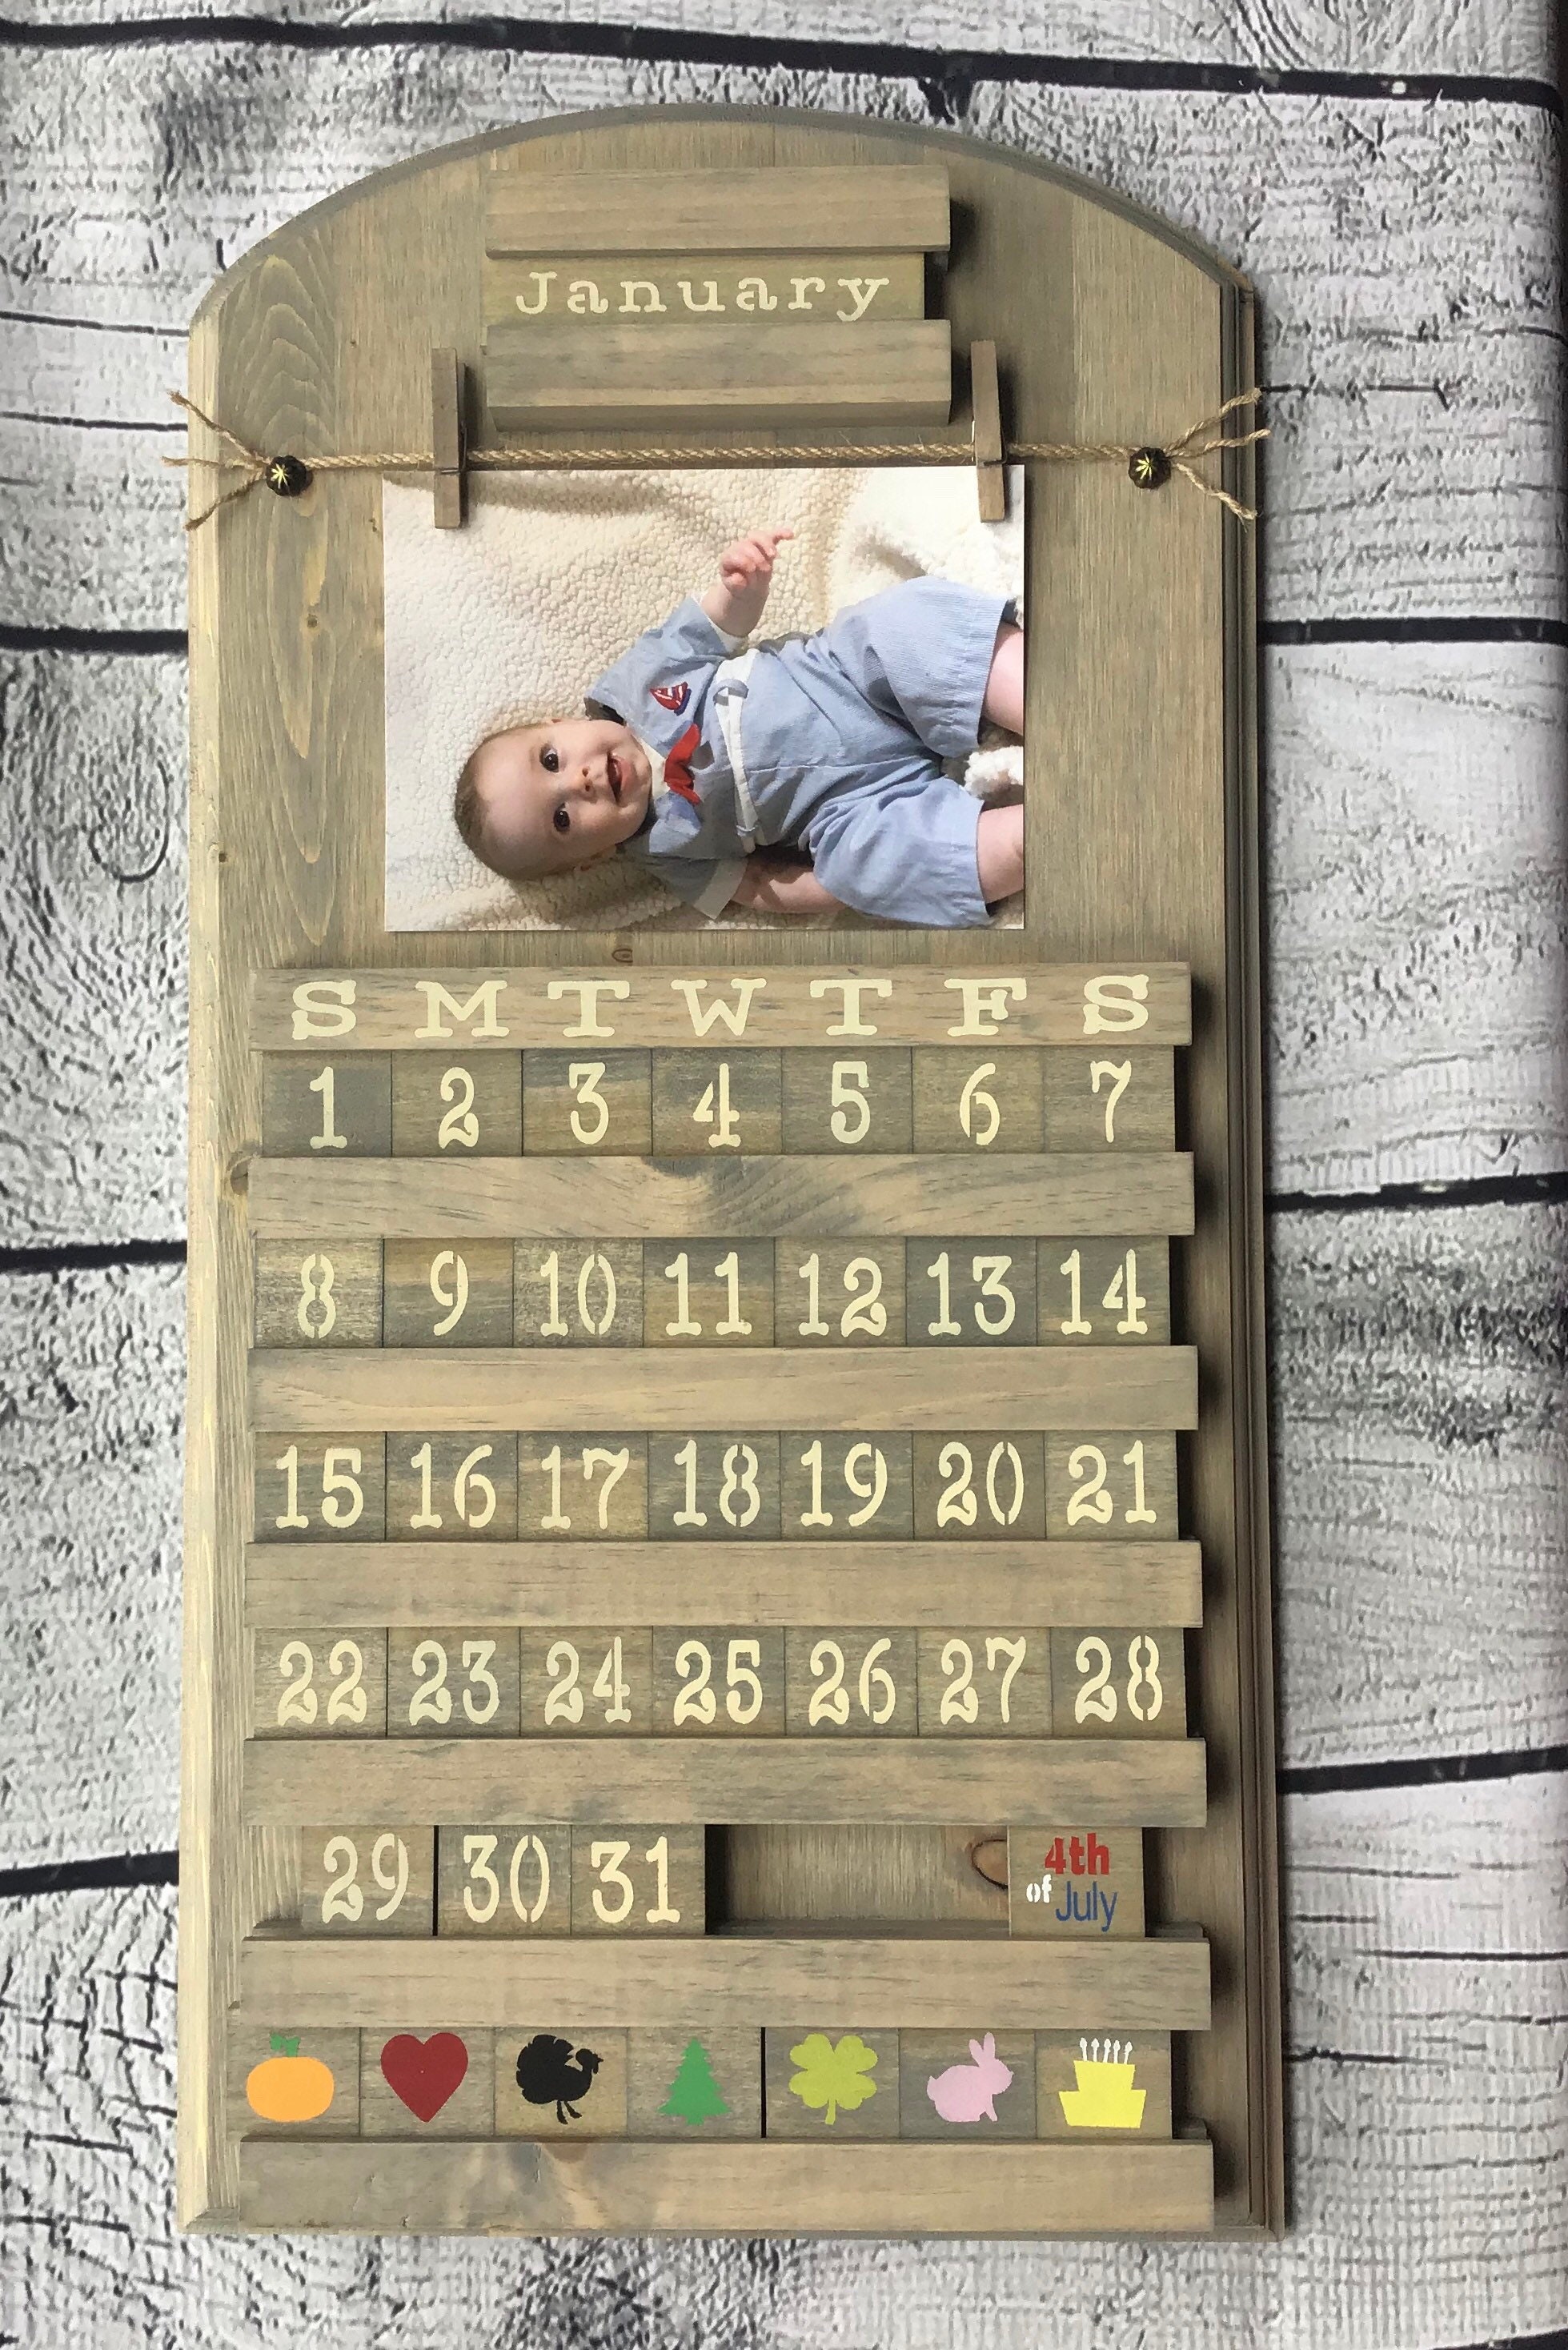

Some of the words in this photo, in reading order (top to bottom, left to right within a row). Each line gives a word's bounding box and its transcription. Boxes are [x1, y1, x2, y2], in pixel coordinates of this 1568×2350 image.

[516, 272, 889, 320] January
[292, 980, 356, 1040] S
[415, 981, 509, 1038] M
[547, 981, 629, 1037] T
[671, 978, 766, 1037] W
[810, 979, 892, 1035] T
[944, 978, 1027, 1037] F
[1083, 974, 1149, 1034] S
[310, 1066, 347, 1148] 1
[439, 1067, 479, 1148] 2
[569, 1063, 608, 1145] 3
[692, 1063, 740, 1147] 4
[831, 1061, 870, 1143] 5
[960, 1063, 1000, 1145] 6
[1090, 1061, 1131, 1142] 7
[297, 1253, 336, 1337] 8
[430, 1251, 468, 1335] 9
[539, 1251, 616, 1336] 10
[665, 1253, 752, 1336] 11
[799, 1253, 886, 1337] 12
[928, 1253, 1015, 1335] 13
[1061, 1249, 1148, 1334] 14
[276, 1446, 363, 1528] 15
[410, 1442, 495, 1529] 16
[541, 1446, 628, 1529] 17
[674, 1440, 760, 1526] 18
[800, 1441, 887, 1526] 19
[937, 1442, 1024, 1527] 20
[1067, 1441, 1156, 1526] 21
[277, 1640, 367, 1726] 22
[409, 1640, 499, 1725] 23
[544, 1637, 631, 1725] 24
[674, 1640, 762, 1726] 25
[808, 1638, 896, 1726] 26
[940, 1637, 1026, 1724] 27
[1075, 1636, 1162, 1723] 28
[322, 1834, 408, 1923] 29
[463, 1835, 550, 1923] 30
[592, 1836, 680, 1923] 31
[1045, 1832, 1110, 1875] 4th
[1026, 1874, 1052, 1903] of
[1055, 1881, 1118, 1932] July
